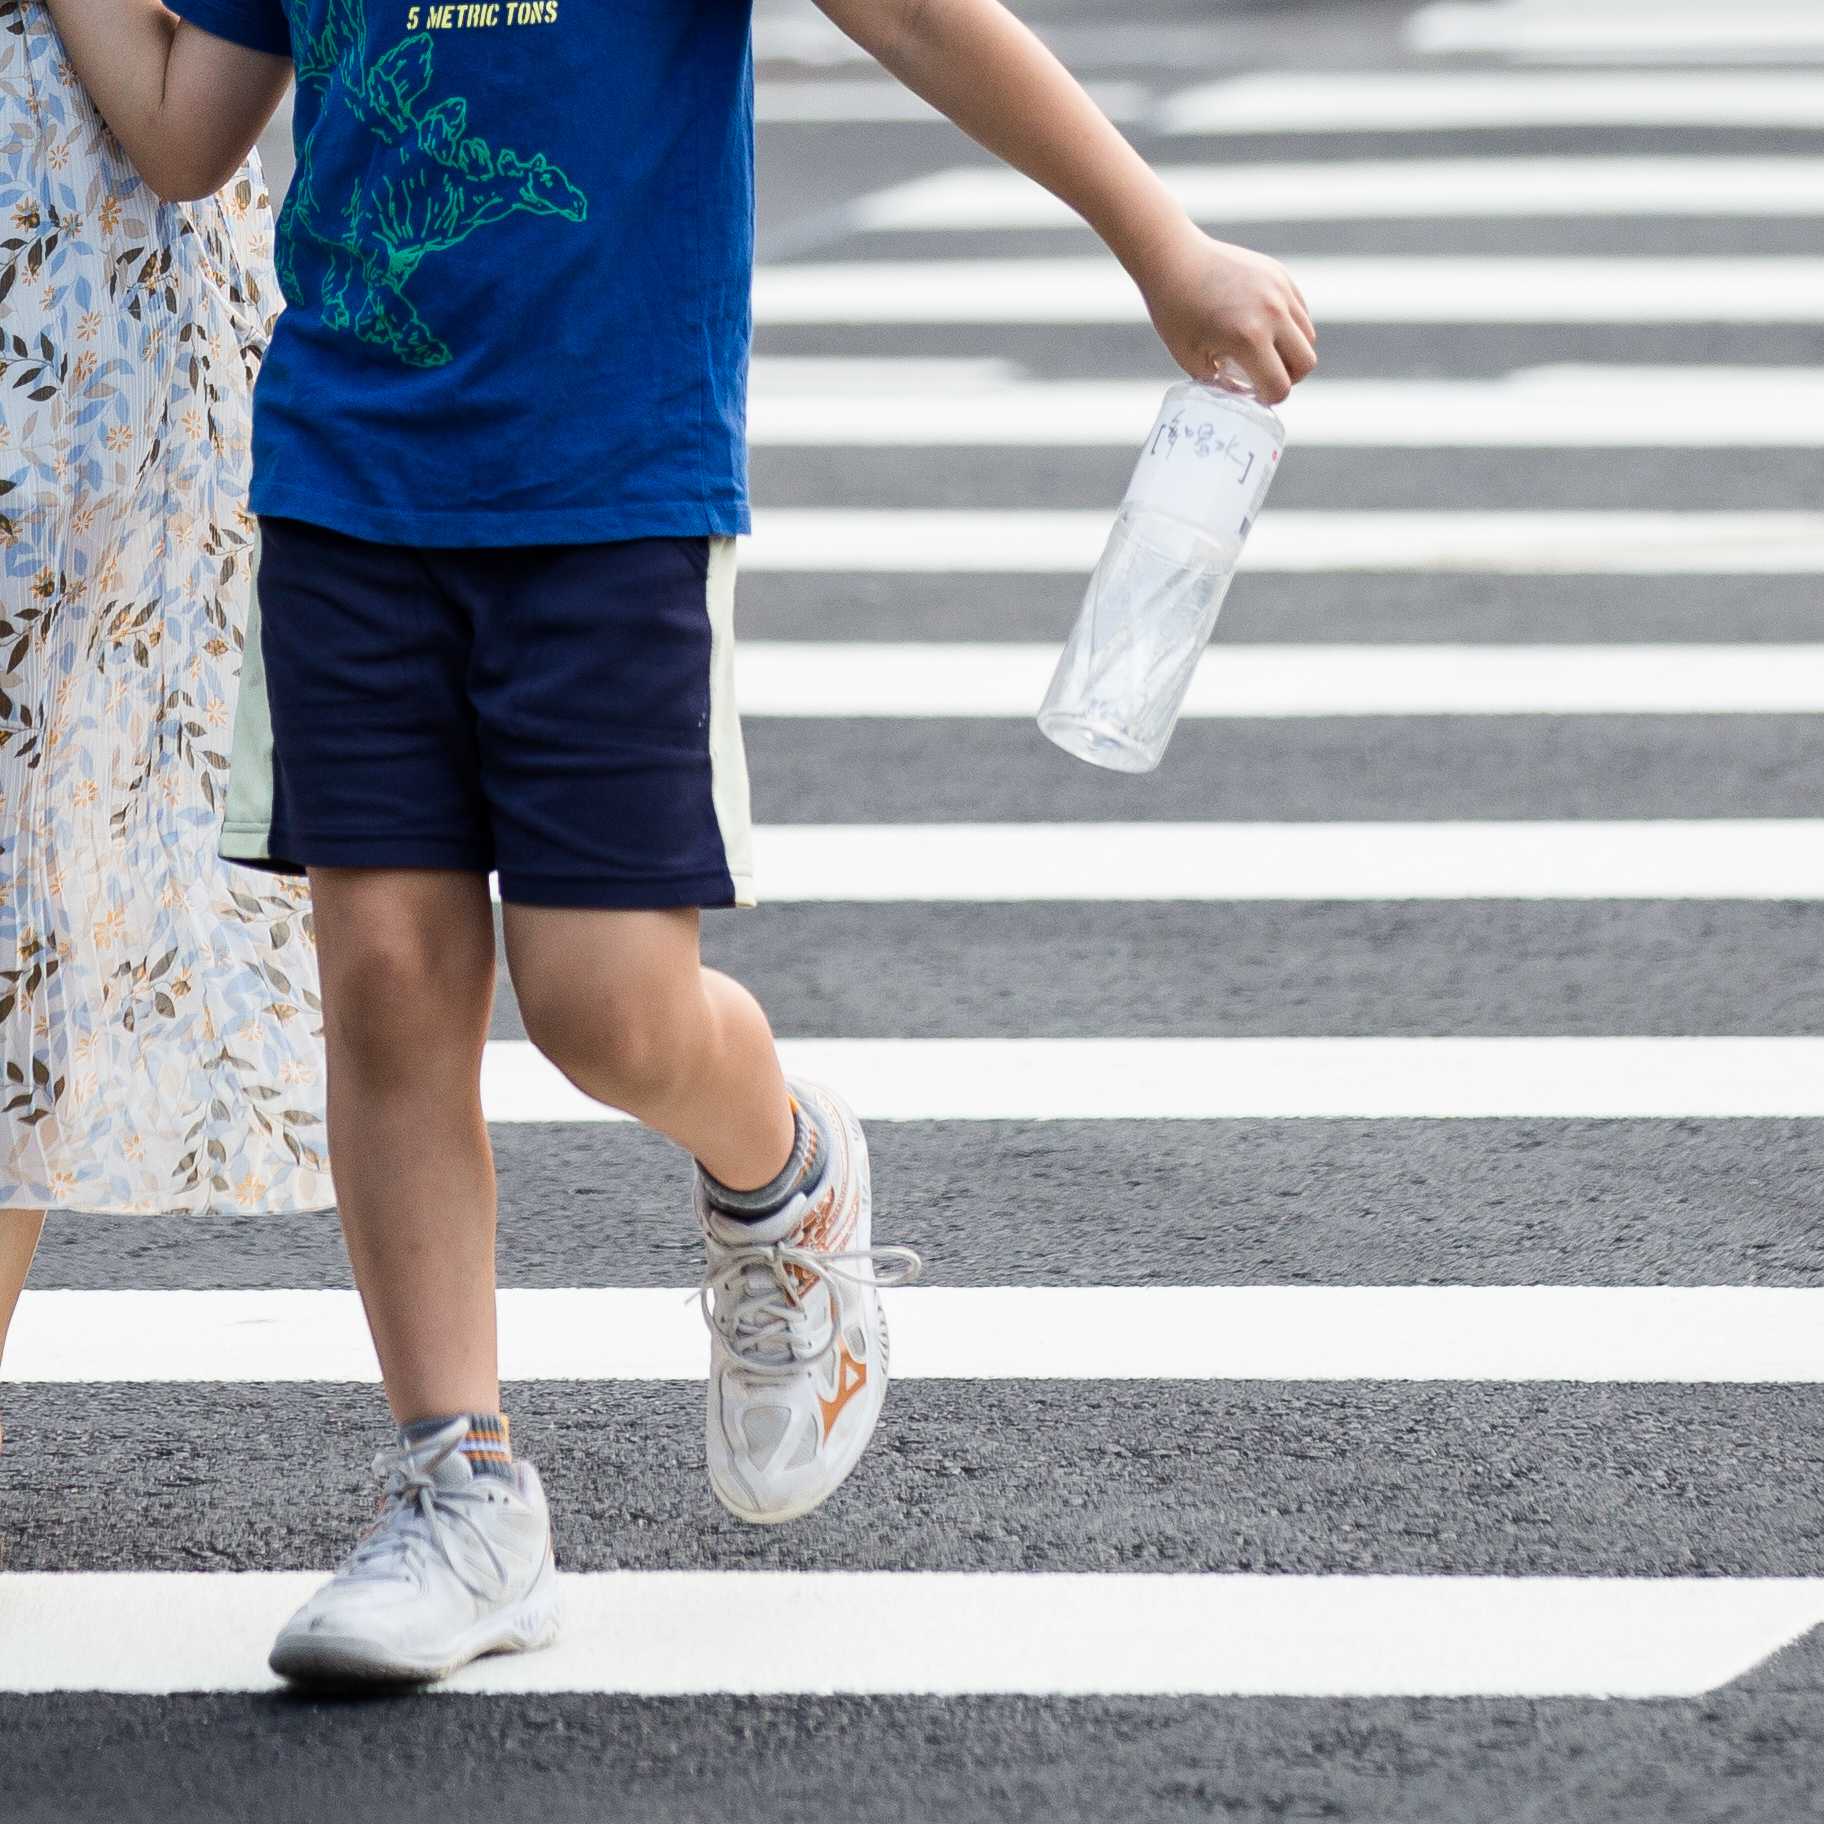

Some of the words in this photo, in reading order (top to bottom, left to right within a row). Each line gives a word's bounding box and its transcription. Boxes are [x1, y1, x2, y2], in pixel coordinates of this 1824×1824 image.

[406, 5, 421, 30] 5
[425, 2, 500, 30] METRIC
[506, 0, 559, 25] TONS
